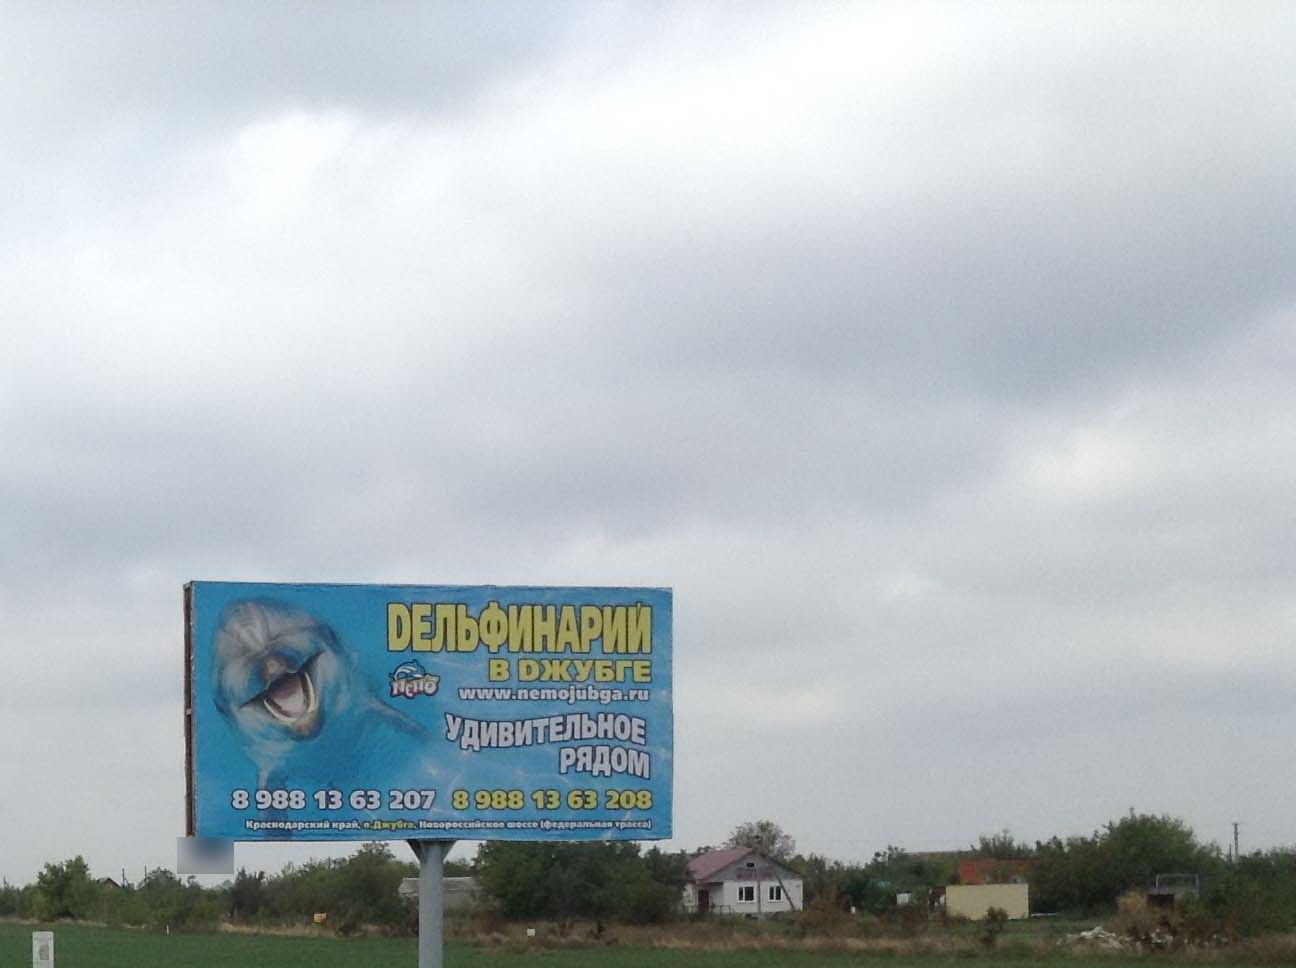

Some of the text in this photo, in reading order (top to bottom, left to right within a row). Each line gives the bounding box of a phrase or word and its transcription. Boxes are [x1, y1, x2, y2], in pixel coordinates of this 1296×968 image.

[488, 658, 510, 682] В
[458, 686, 650, 704] www.nemojubga.ru
[445, 712, 647, 752] УДИВИТЕЛЬНОЕ
[559, 745, 651, 780] РЯДОМ
[231, 789, 436, 810] 8 988 13 63 207
[452, 789, 653, 810] 8 988 13 63 208
[246, 820, 330, 830] Краснодарский
[332, 820, 361, 830] край,
[419, 820, 505, 830] Новороссийское
[507, 821, 538, 829] шоссе
